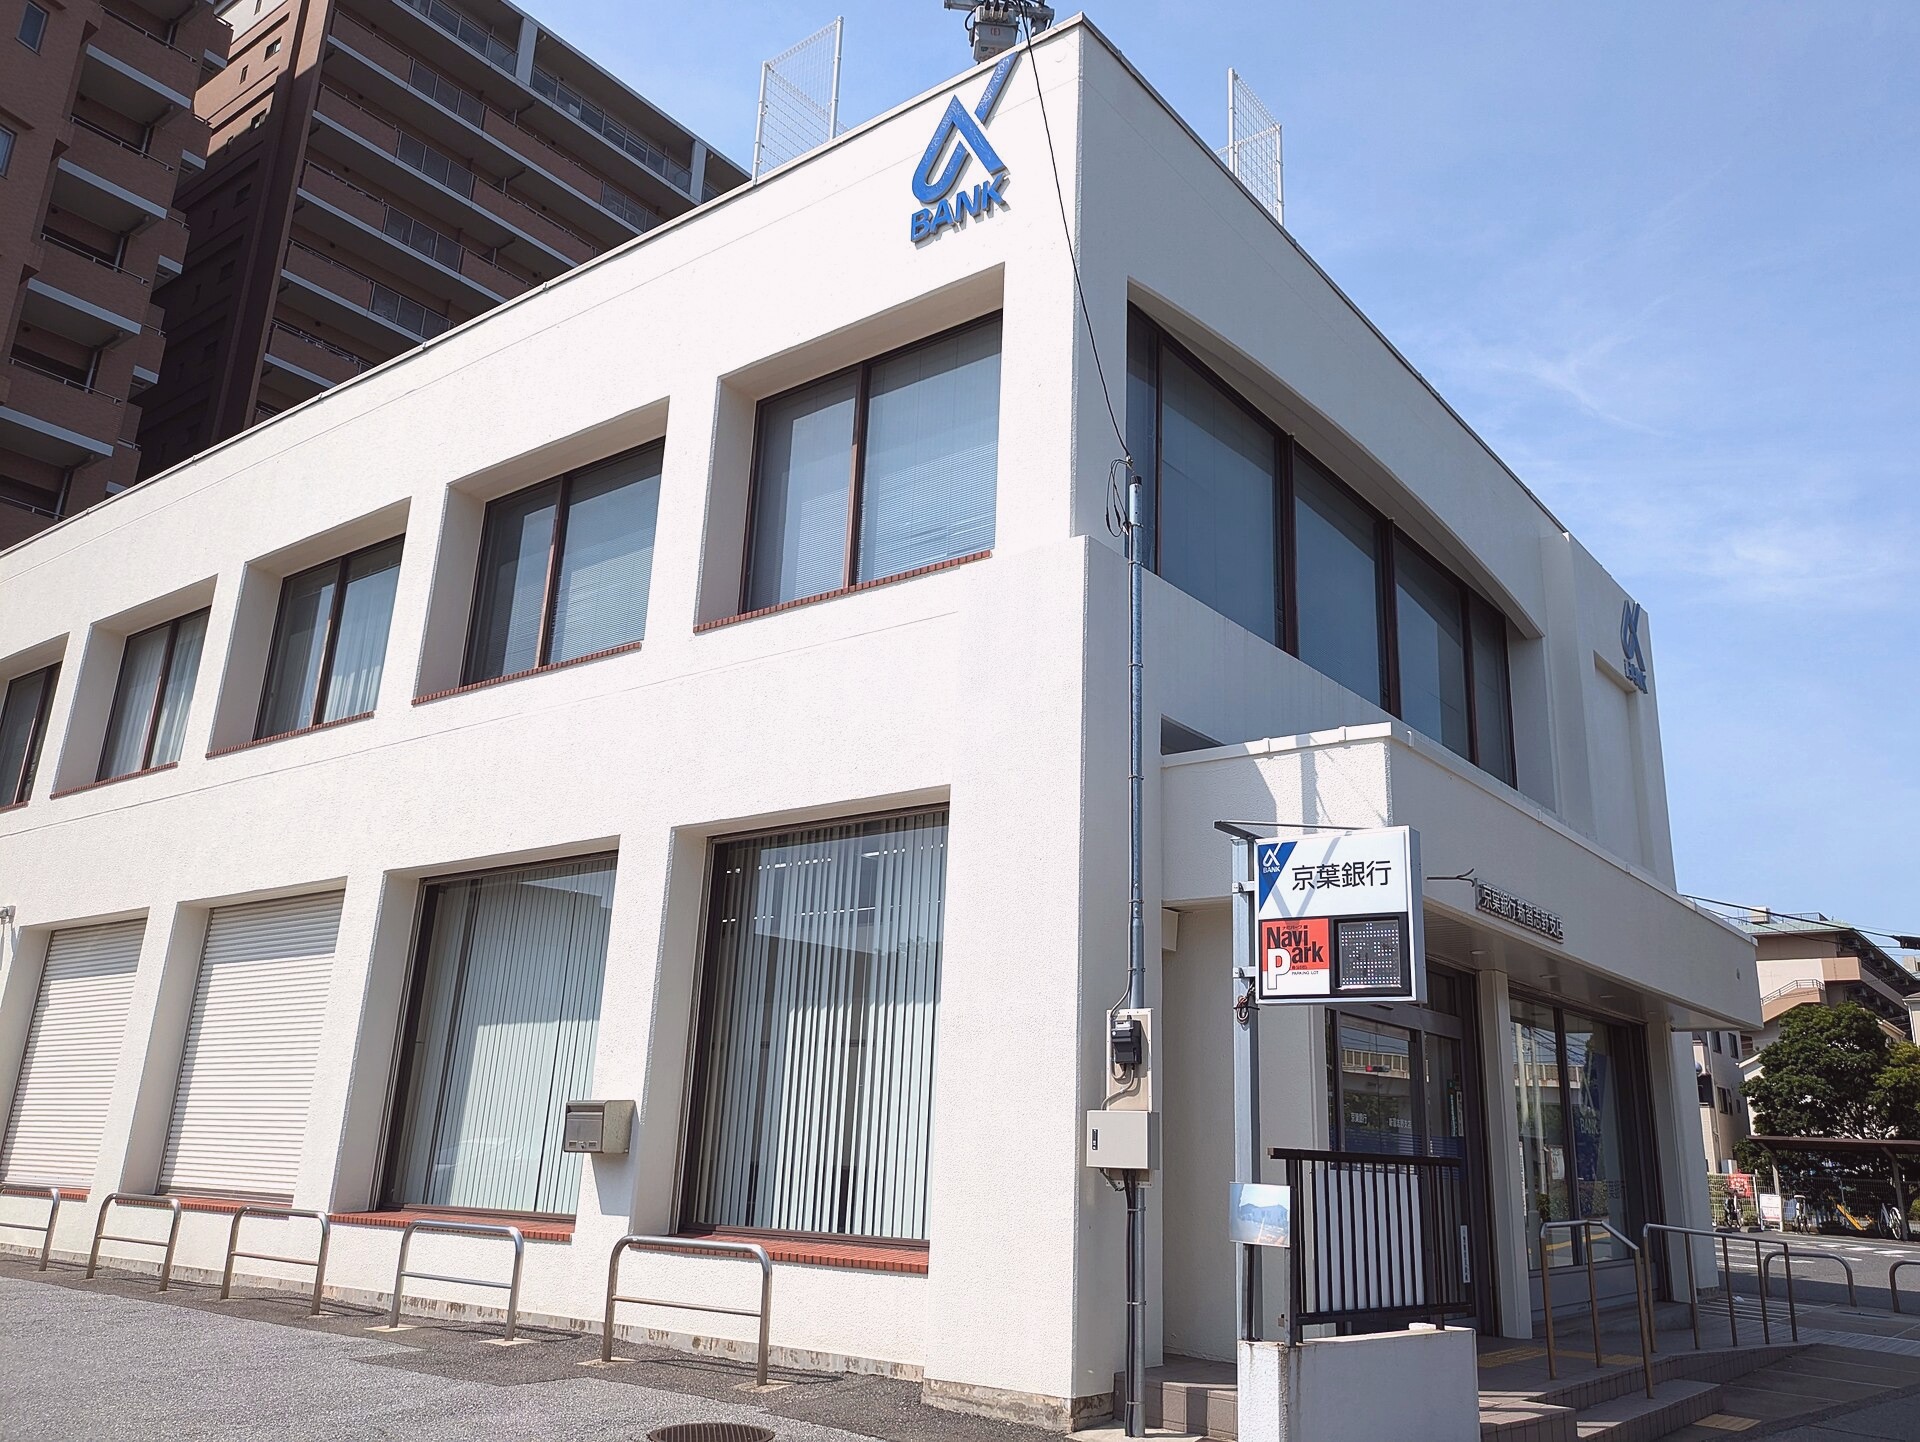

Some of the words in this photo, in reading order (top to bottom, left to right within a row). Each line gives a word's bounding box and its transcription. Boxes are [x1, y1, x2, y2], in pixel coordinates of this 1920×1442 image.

[911, 174, 1007, 242] BANK
[1291, 860, 1392, 891] 京葉銀行
[1267, 925, 1308, 949] Navi
[1267, 941, 1324, 990] Park
